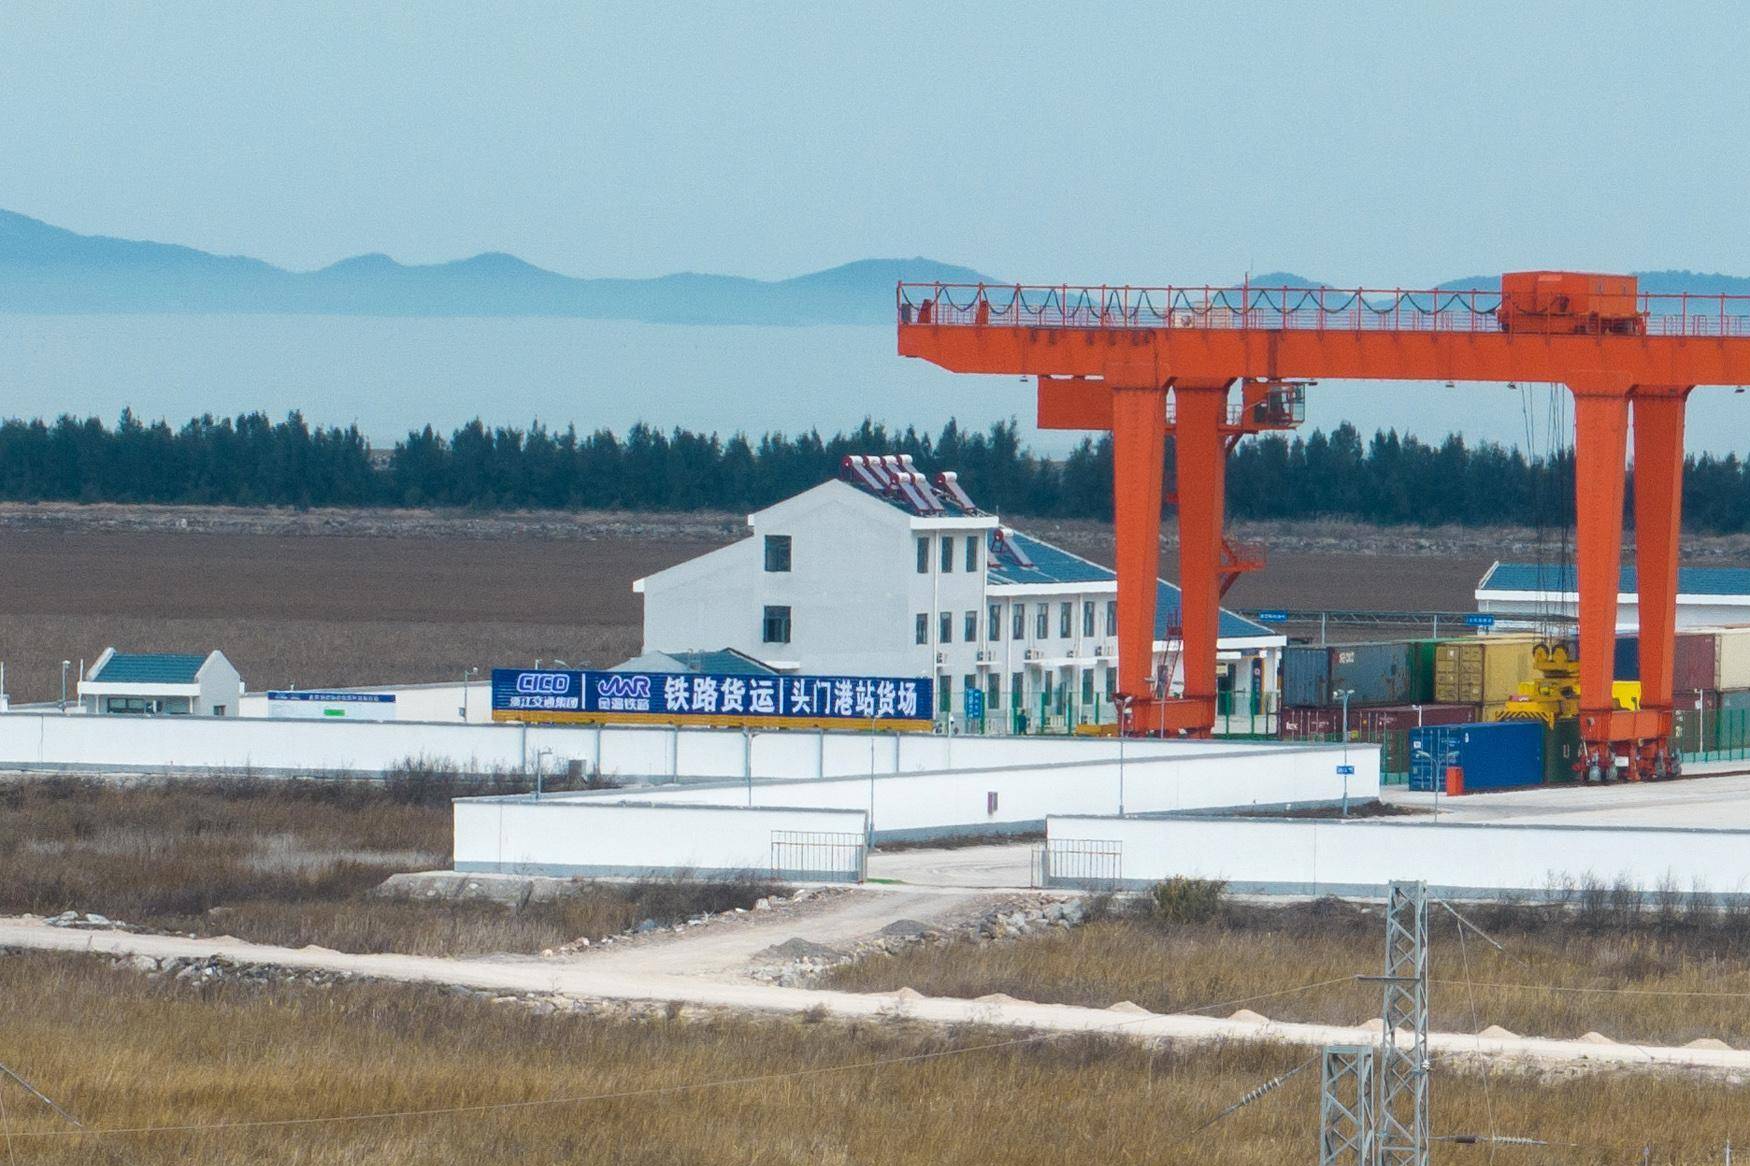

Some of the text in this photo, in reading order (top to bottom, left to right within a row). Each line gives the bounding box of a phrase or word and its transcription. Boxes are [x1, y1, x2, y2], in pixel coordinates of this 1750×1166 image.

[516, 673, 570, 693] CICO
[509, 696, 579, 709] 浙江交通集团
[664, 676, 918, 716] 铁路货运 头门港站货场
